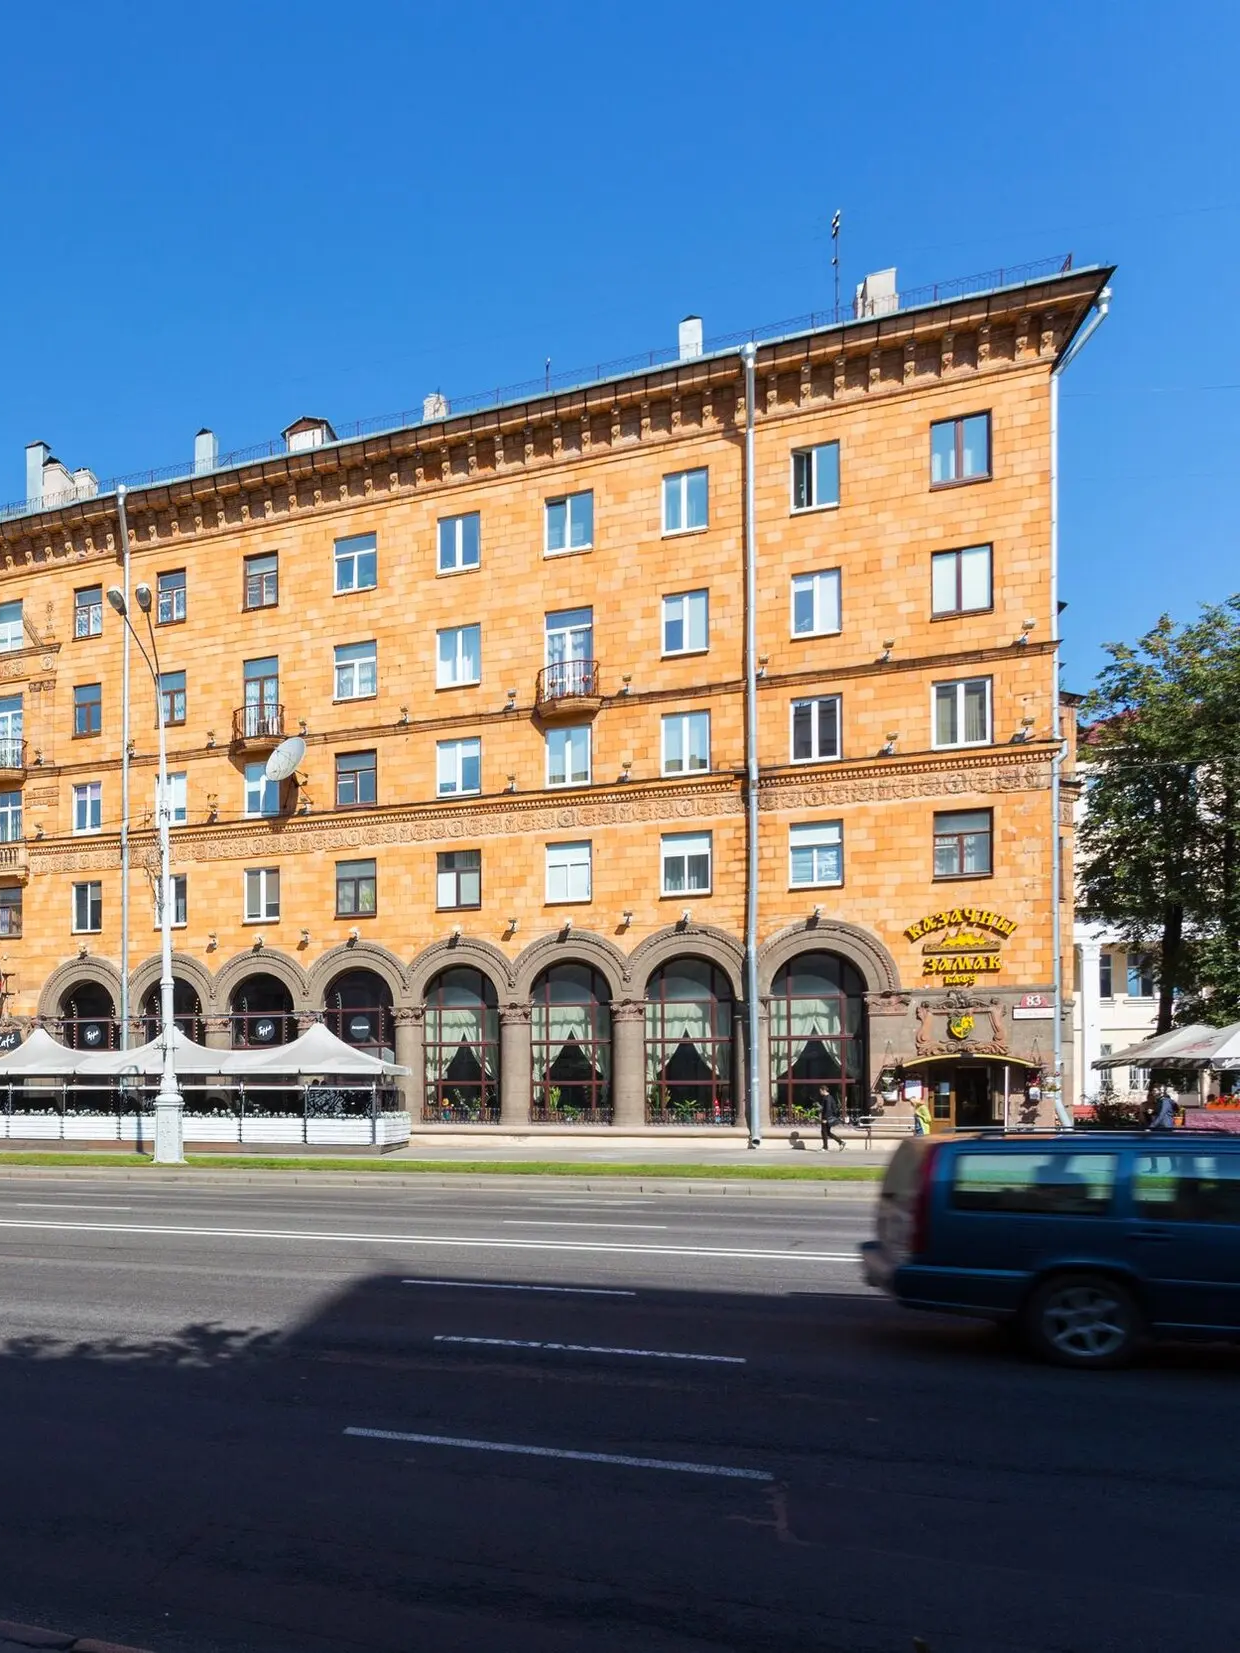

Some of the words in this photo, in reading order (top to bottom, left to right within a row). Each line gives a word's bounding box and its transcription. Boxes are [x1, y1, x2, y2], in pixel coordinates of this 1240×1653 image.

[903, 907, 1018, 943] КАЗАЧНЫ
[921, 955, 1001, 976] ЗАМАК
[1026, 994, 1042, 1006] 83
